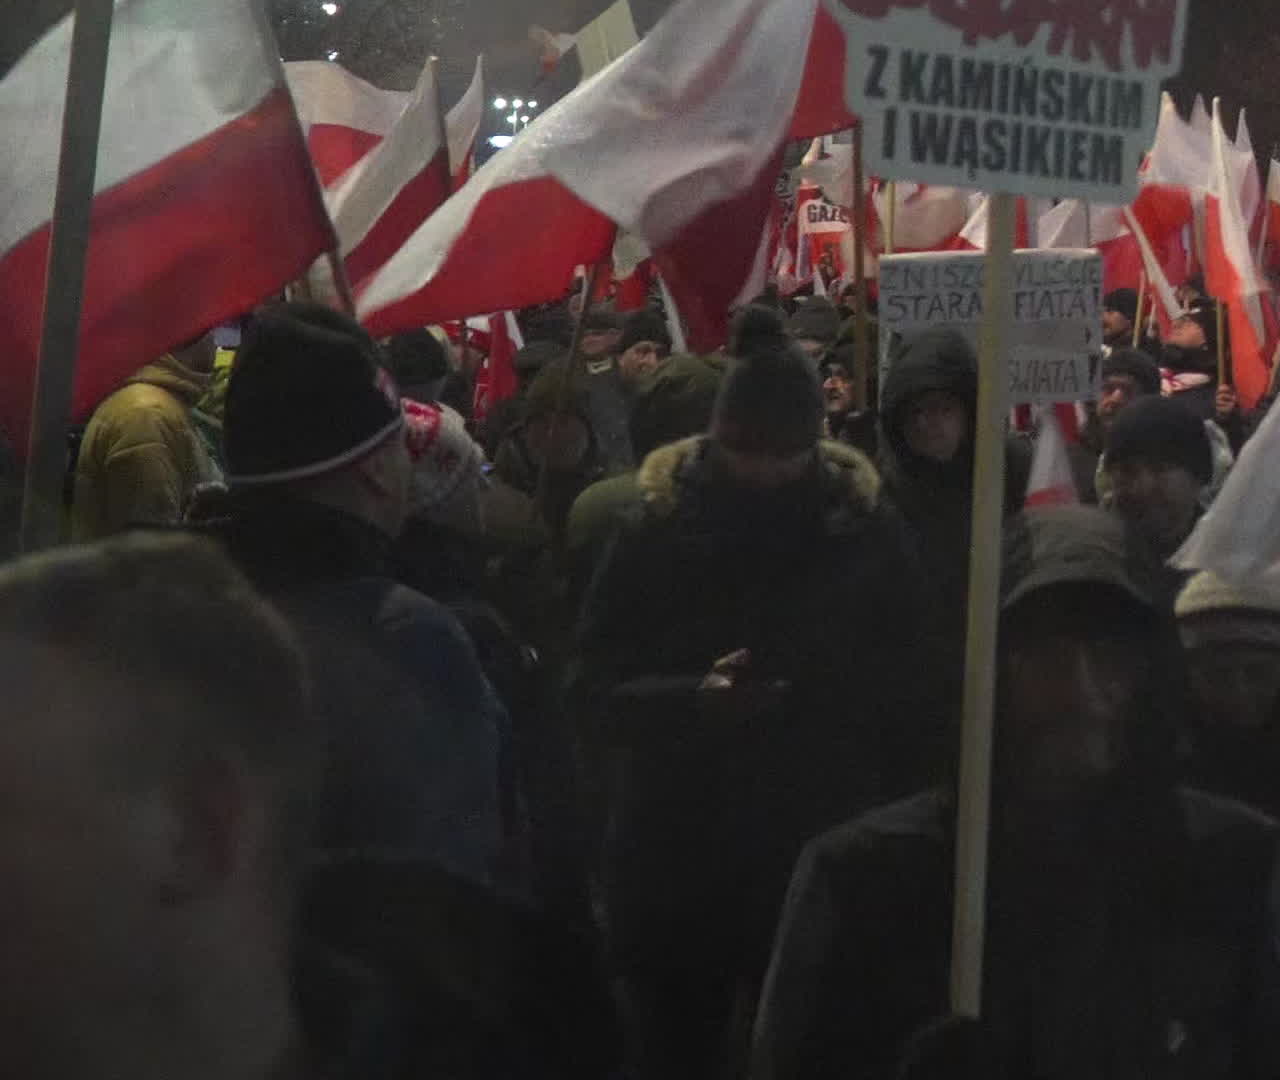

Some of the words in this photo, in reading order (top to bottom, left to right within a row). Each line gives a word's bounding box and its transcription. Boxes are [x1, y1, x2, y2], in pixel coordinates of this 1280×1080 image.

[864, 44, 889, 99] Z
[900, 48, 1143, 129] KAMIŃSKIM
[882, 109, 897, 160] I
[910, 111, 1125, 185] WĄSIKIEM
